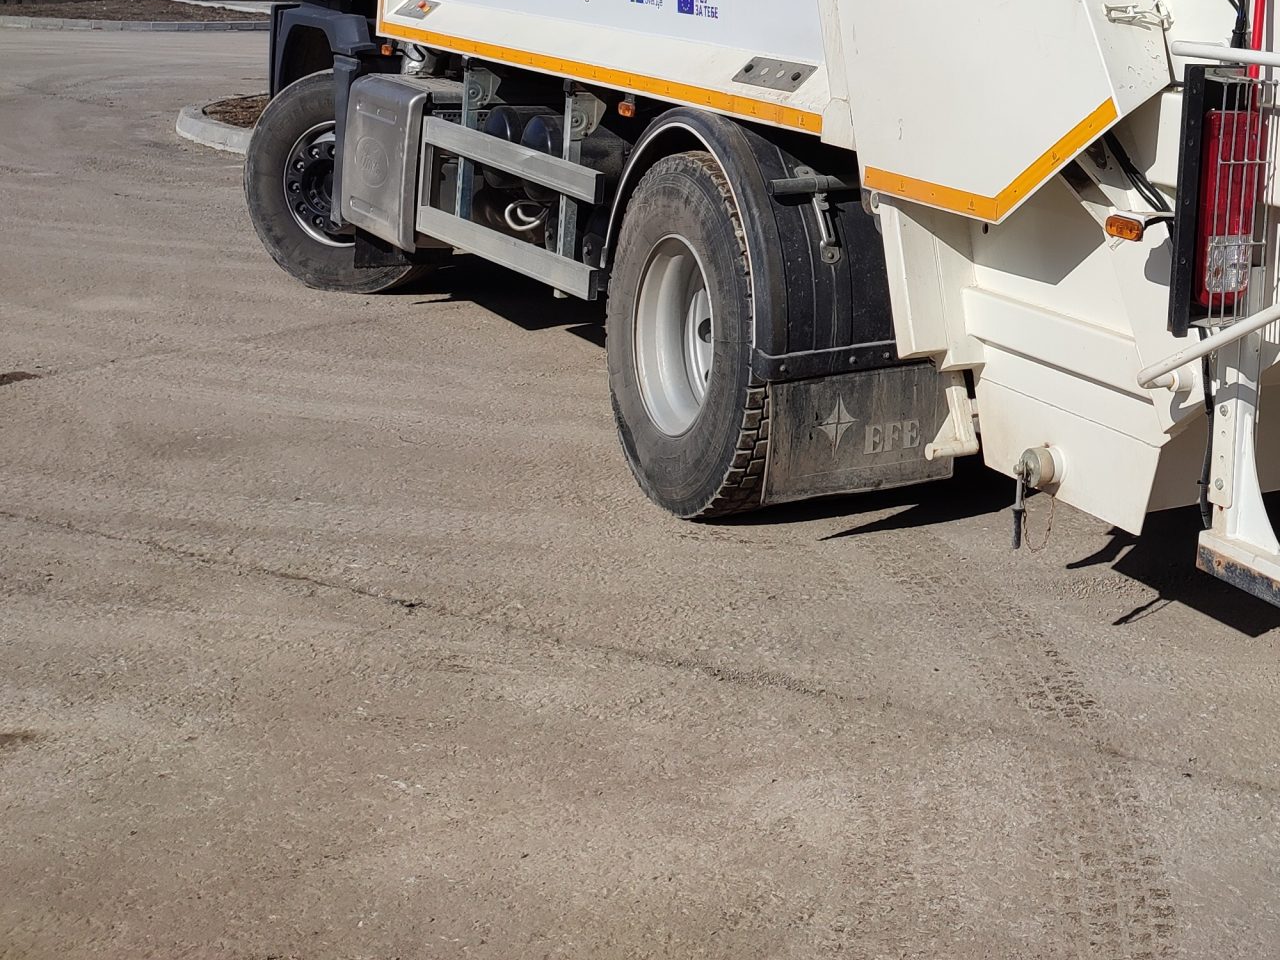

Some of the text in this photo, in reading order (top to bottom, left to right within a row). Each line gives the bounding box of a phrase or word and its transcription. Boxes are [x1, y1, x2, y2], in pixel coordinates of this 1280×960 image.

[695, 4, 719, 19] ЗА ТЕБЕ
[863, 419, 921, 455] EFE
